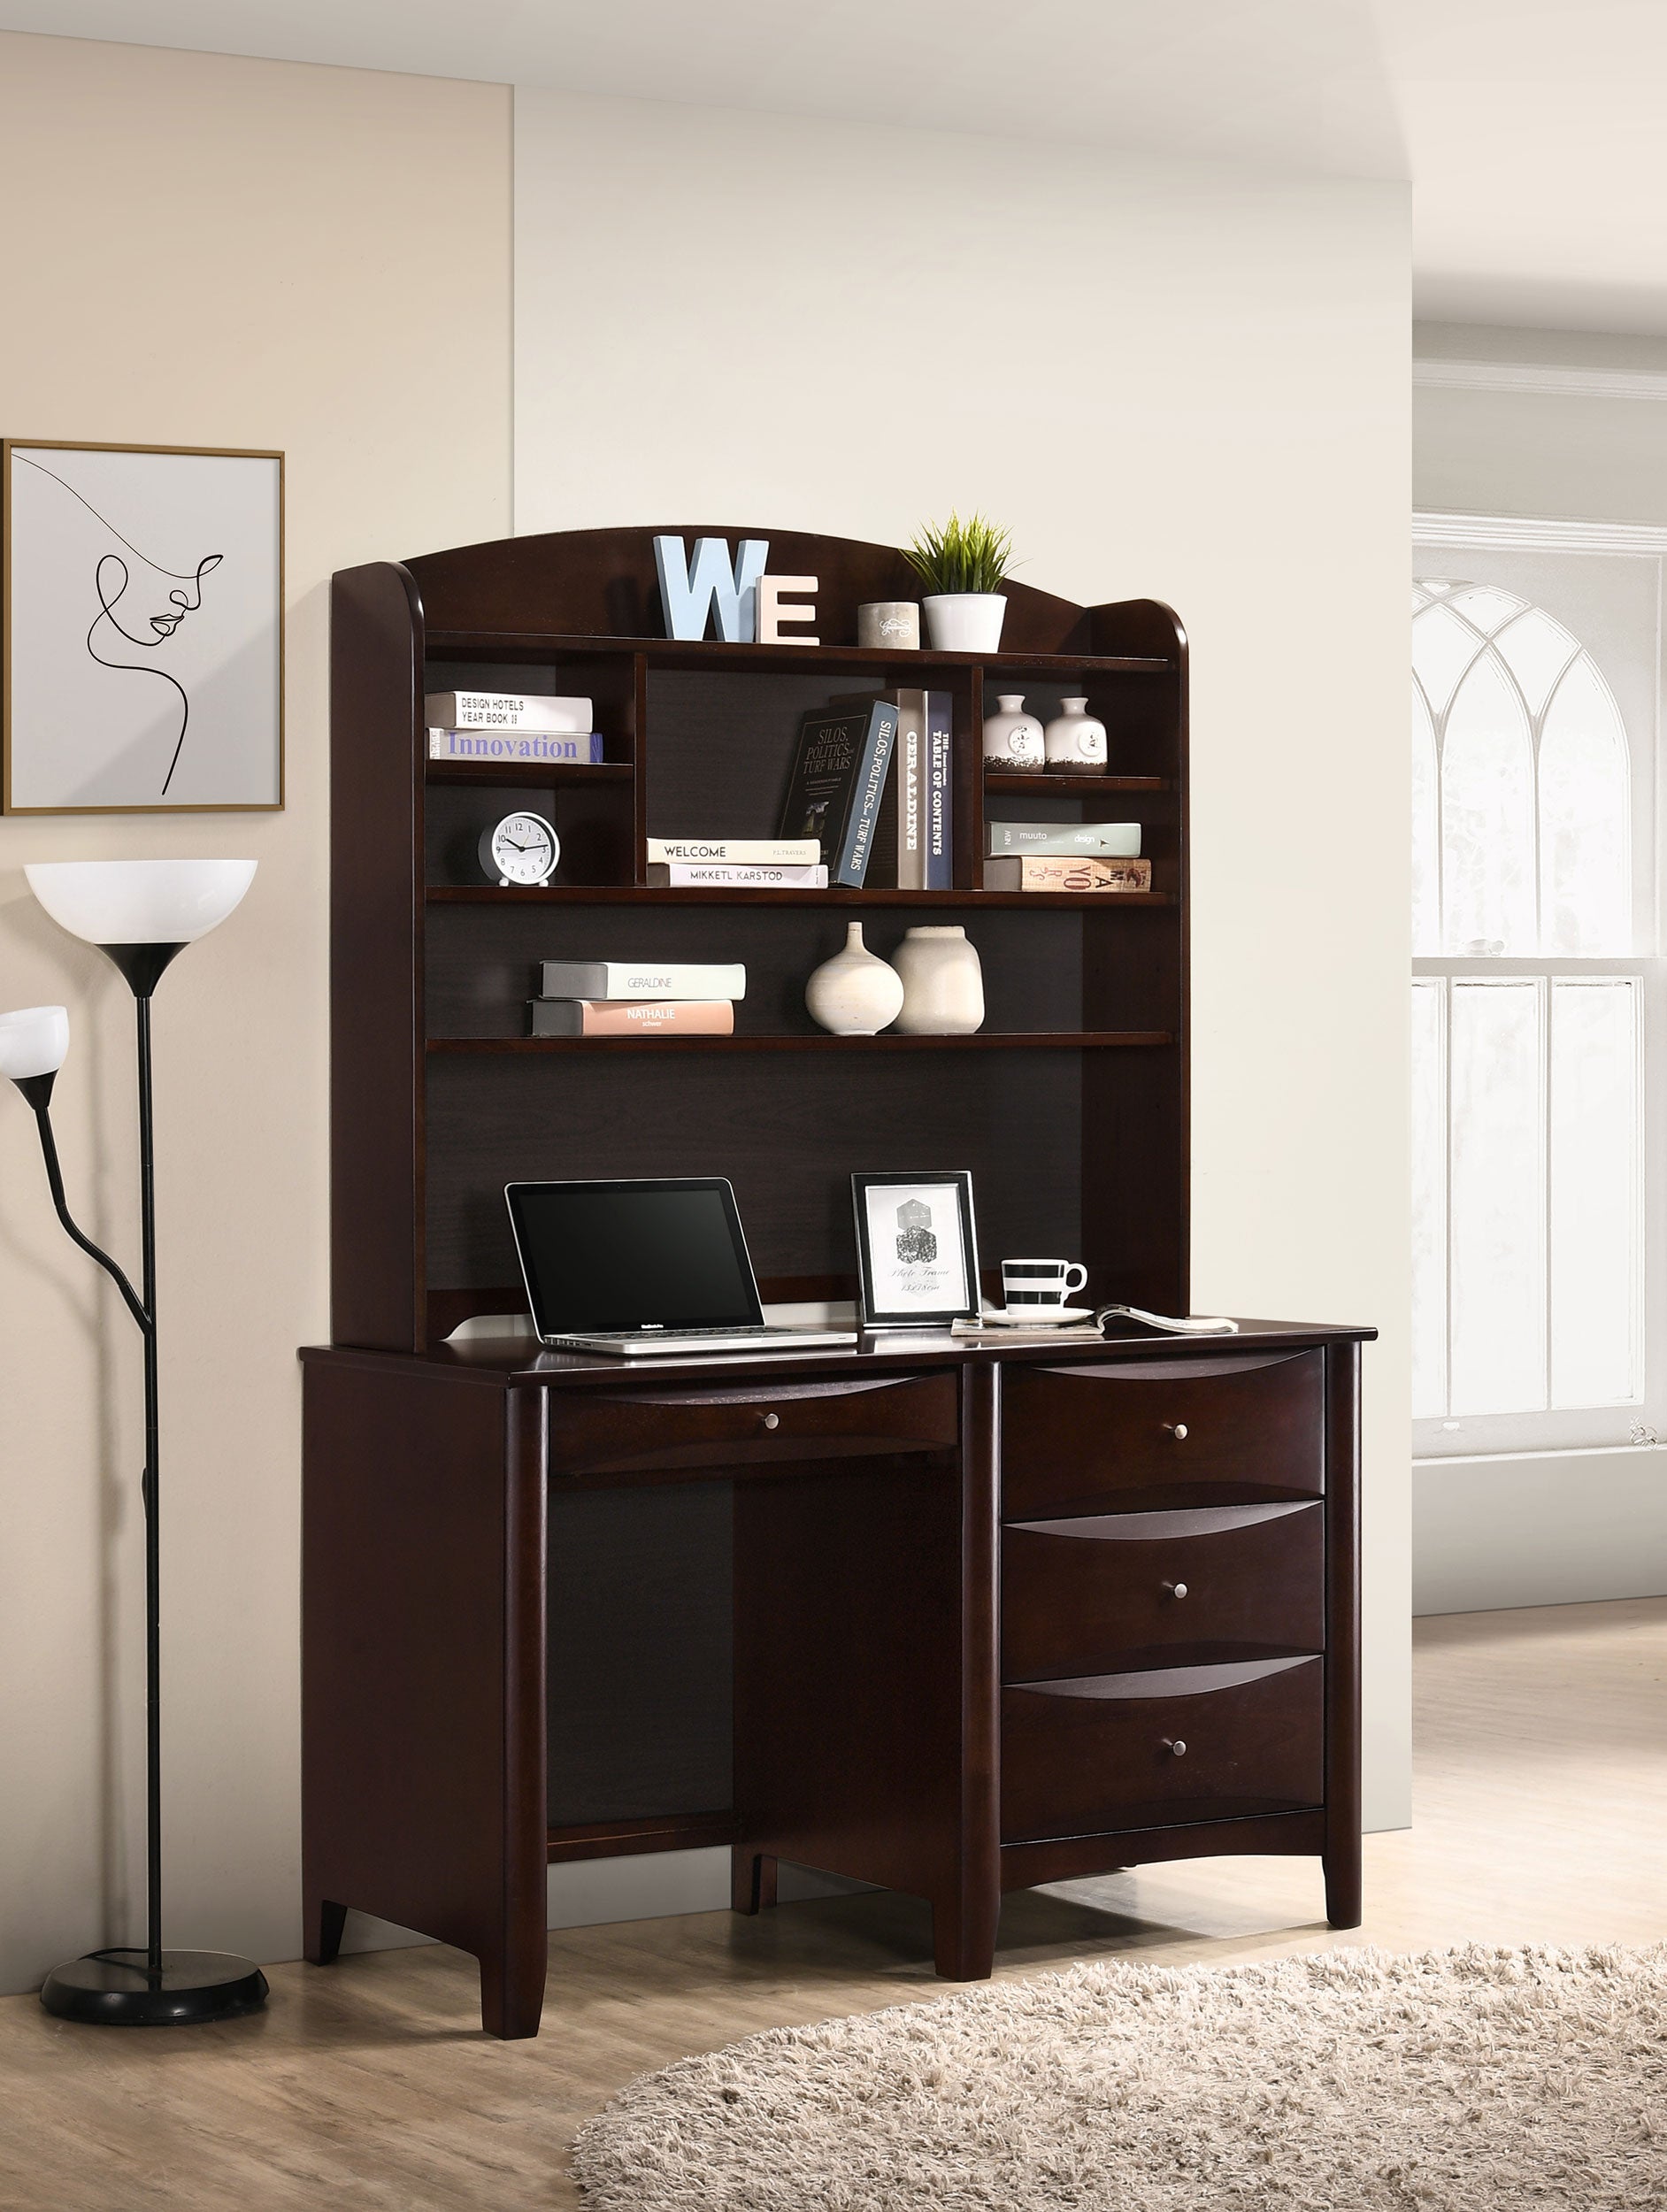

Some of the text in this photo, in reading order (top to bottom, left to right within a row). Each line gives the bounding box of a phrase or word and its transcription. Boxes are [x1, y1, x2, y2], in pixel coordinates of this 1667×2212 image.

[462, 697, 524, 711] DESIGN HOTELS
[462, 711, 483, 723] YEAR
[487, 712, 508, 724] BOOK
[448, 732, 578, 758] Innovation
[806, 742, 850, 760] POLITICS
[803, 756, 851, 774] TURF WARS
[864, 757, 883, 809] POLITICS
[933, 730, 942, 856] TABLE OF CONTENTS
[536, 833, 542, 841] 2
[857, 818, 871, 844] TURF
[1073, 834, 1095, 845] design
[664, 846, 726, 857] WELCOME
[850, 844, 865, 871] WARS
[531, 864, 536, 873] 5
[690, 871, 783, 881] MIKKETL KARSTOD
[628, 978, 672, 988] GERALDINE
[626, 1009, 676, 1019] NATHALIE
